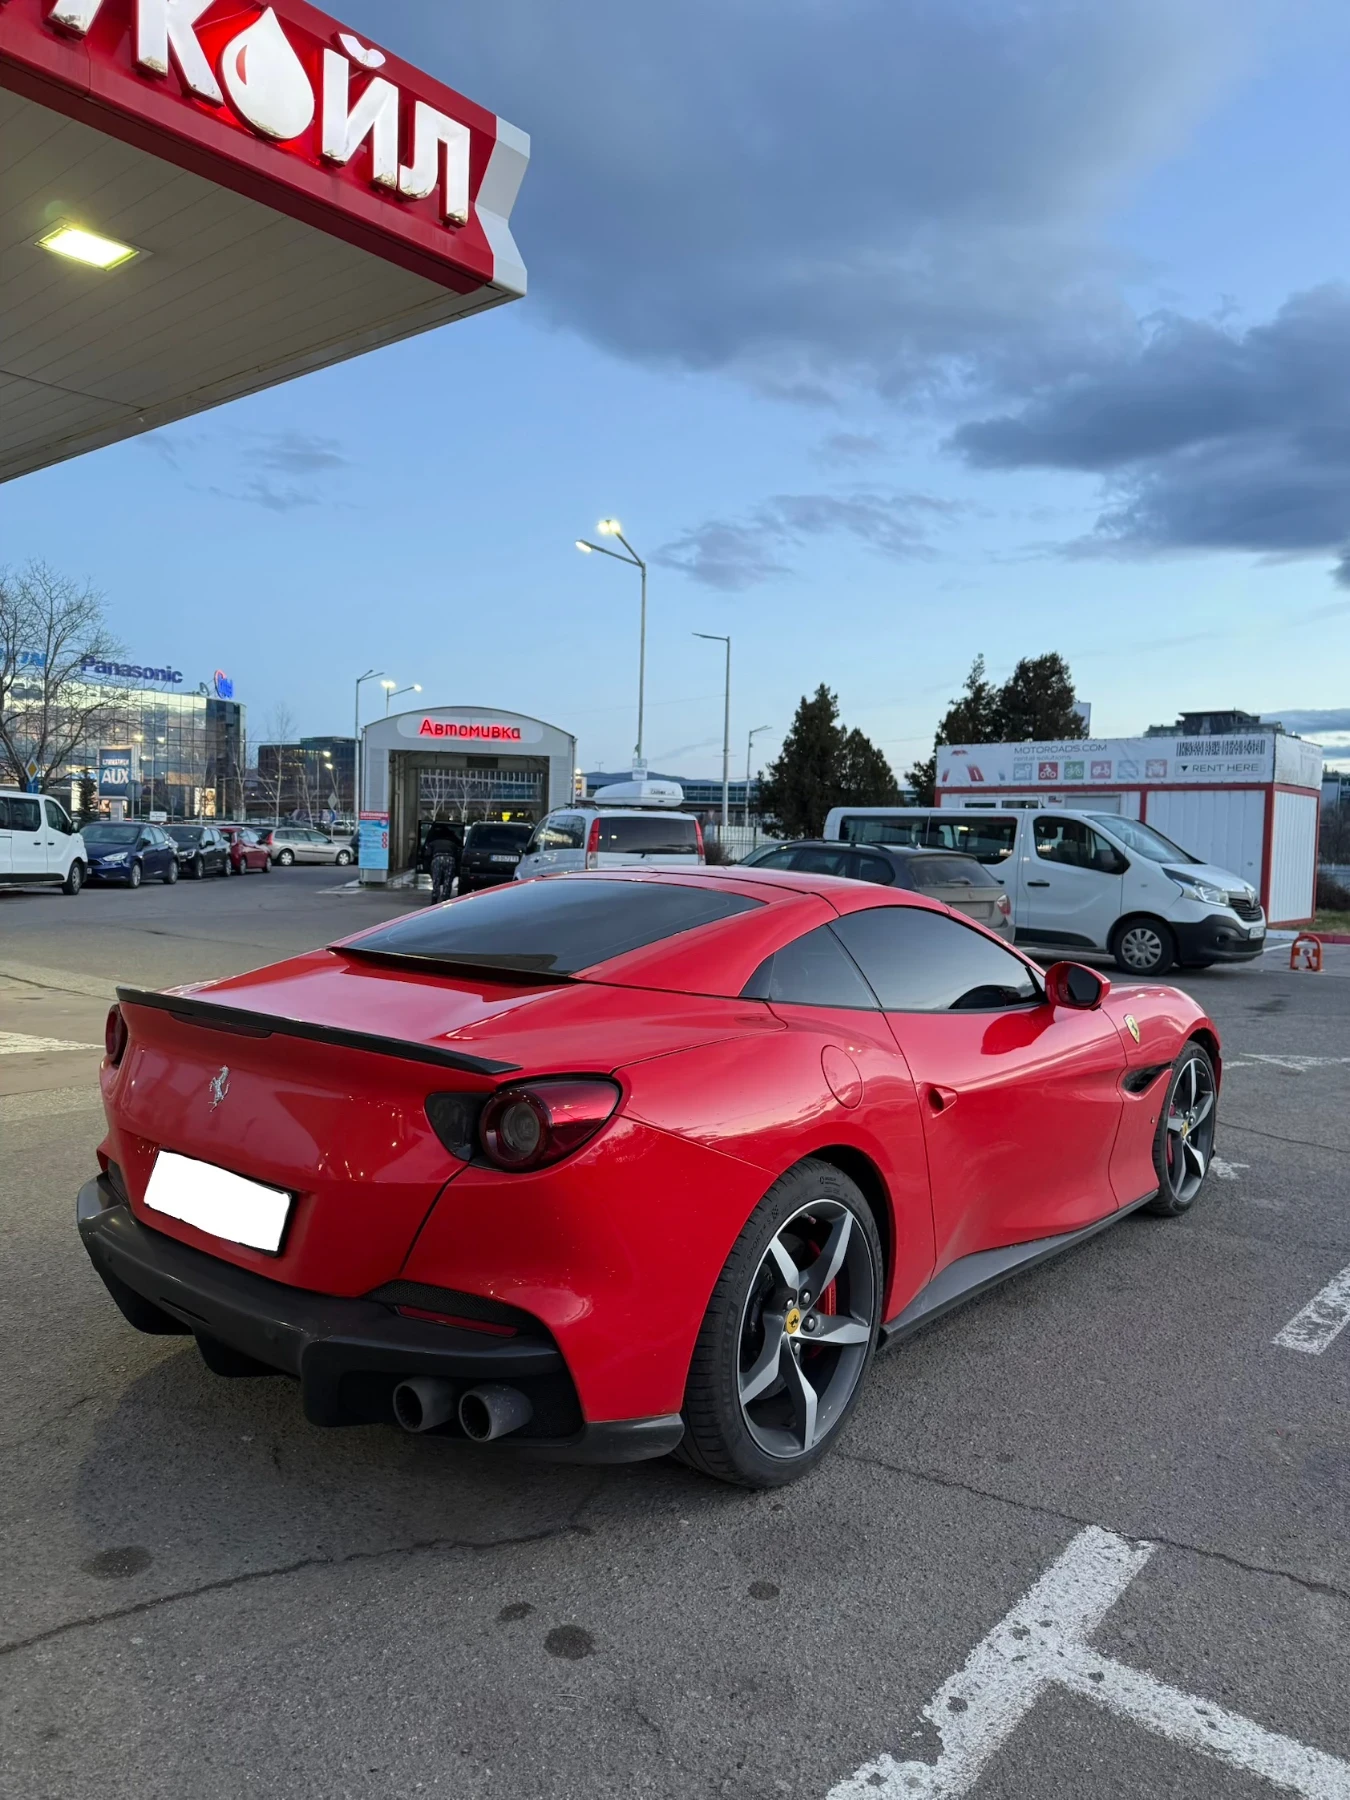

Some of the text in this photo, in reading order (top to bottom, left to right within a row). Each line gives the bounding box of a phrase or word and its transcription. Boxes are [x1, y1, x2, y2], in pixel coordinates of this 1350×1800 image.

[80, 655, 184, 684] Panasonic
[419, 718, 522, 740] Автомивка
[1014, 743, 1108, 755] MOTOROADS.COM
[1013, 754, 1036, 762] rental
[1192, 762, 1260, 773] RENT HERE
[101, 767, 129, 784] AUX
